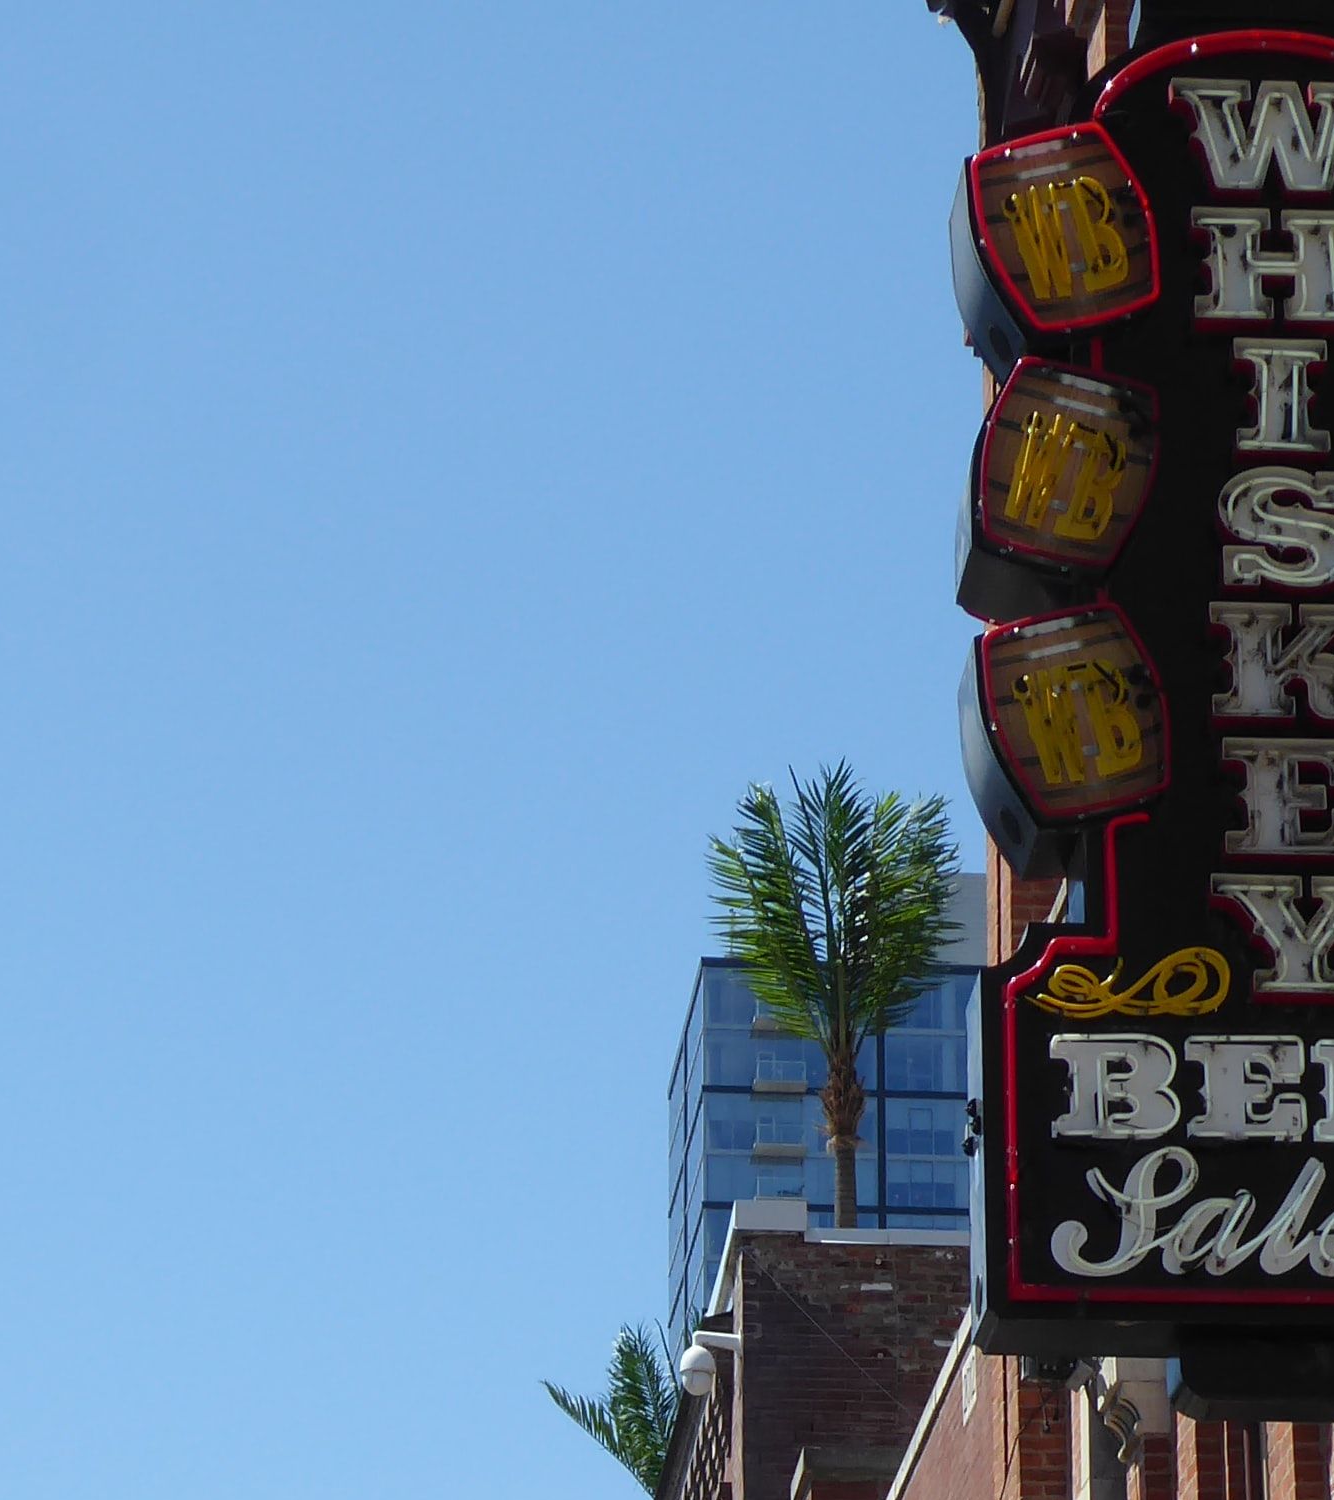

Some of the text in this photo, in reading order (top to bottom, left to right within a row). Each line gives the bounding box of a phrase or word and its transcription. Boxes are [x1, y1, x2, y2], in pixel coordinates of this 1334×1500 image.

[1003, 177, 1128, 300] WB
[1004, 411, 1127, 540] WB
[1012, 659, 1144, 784] WB
